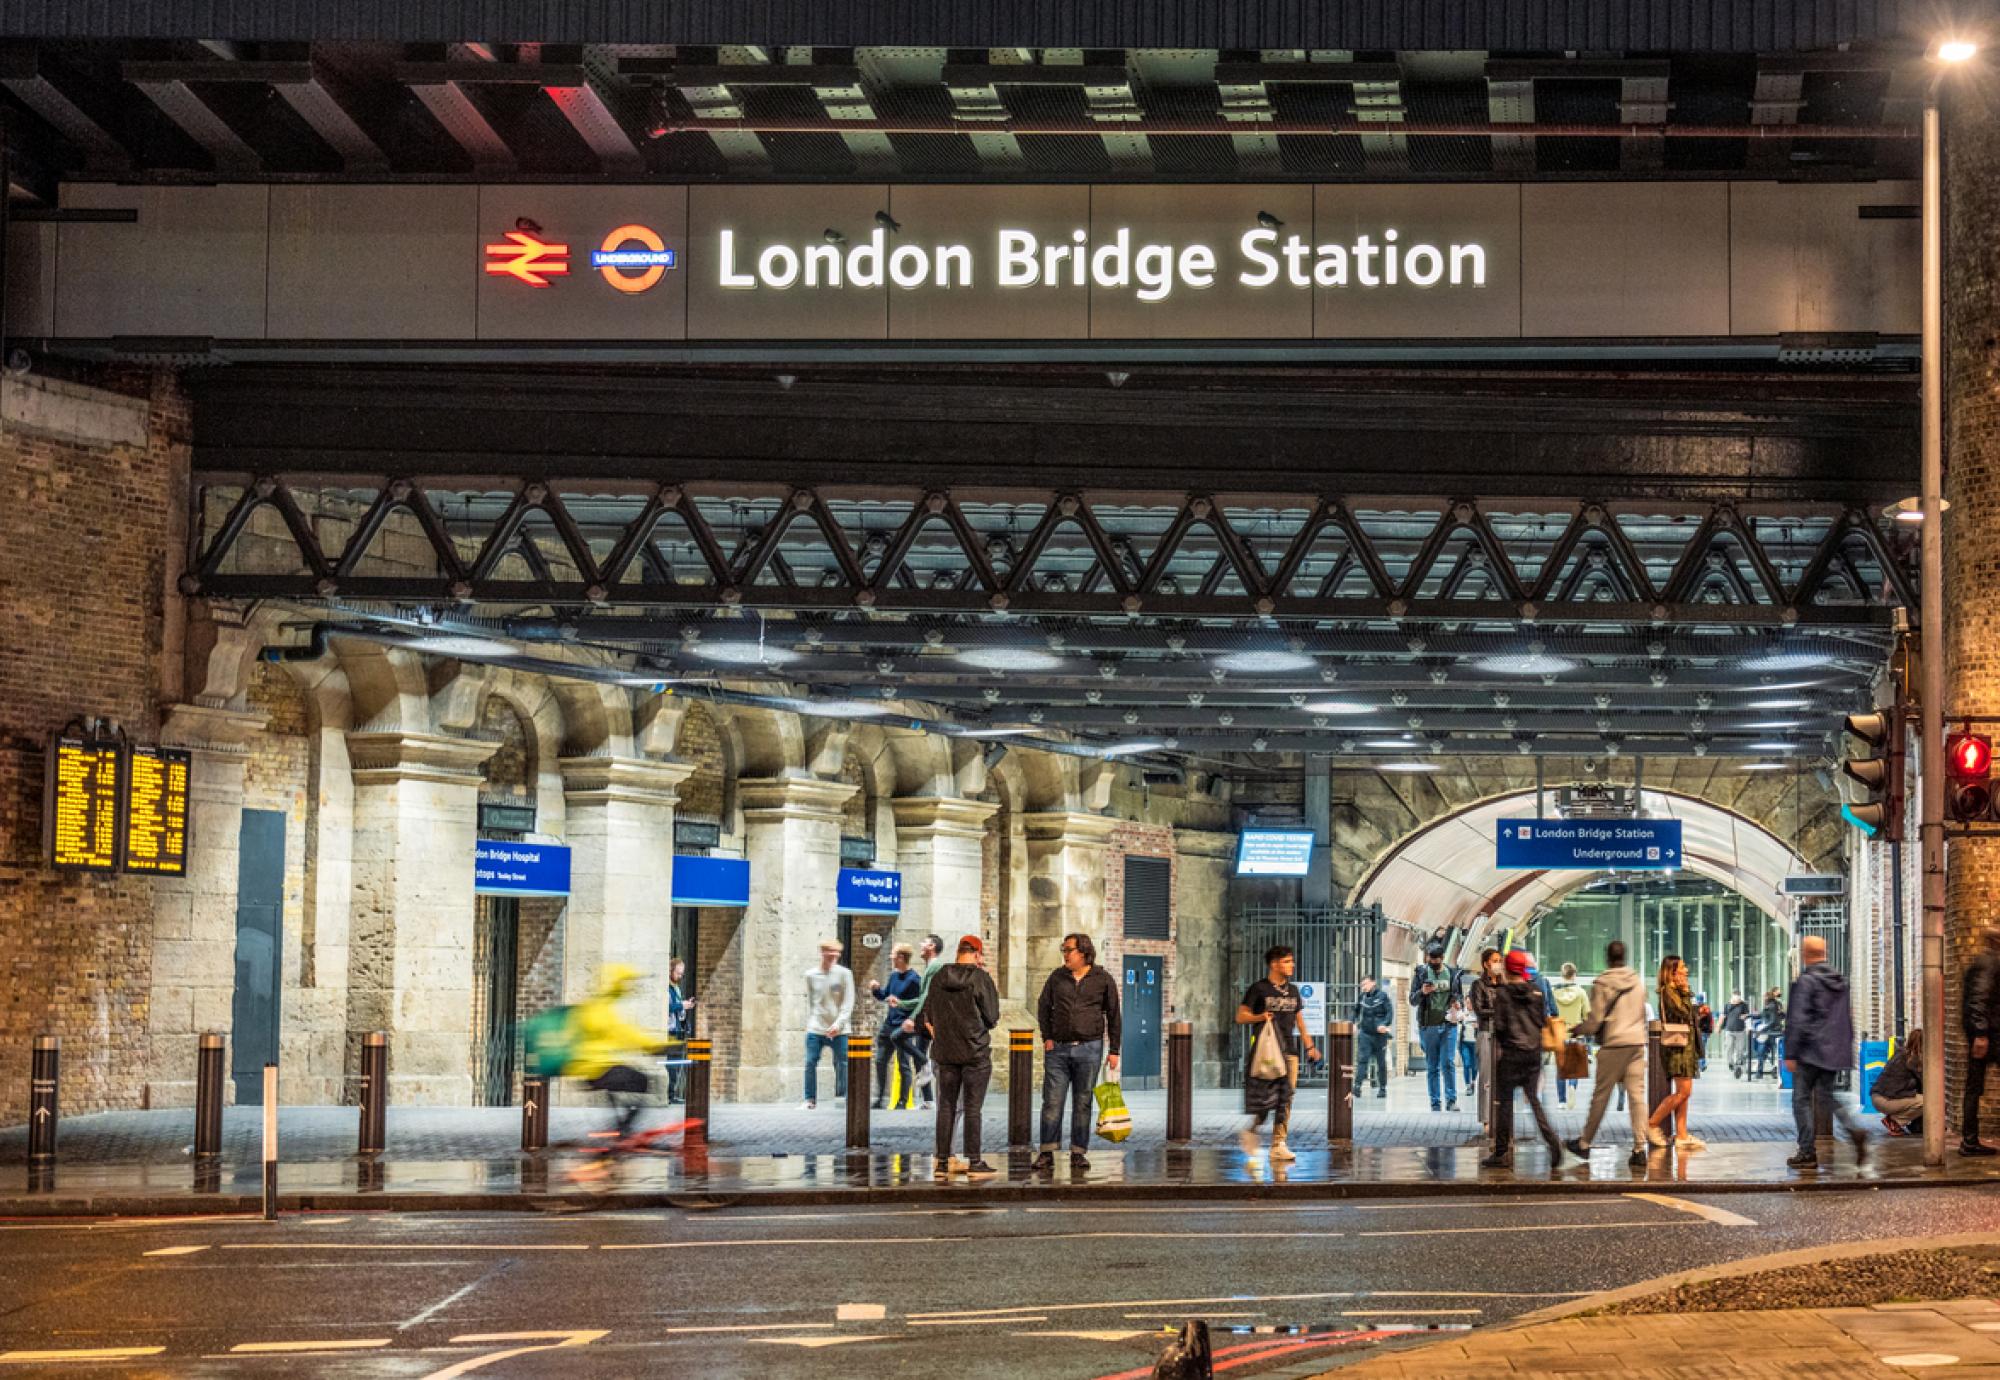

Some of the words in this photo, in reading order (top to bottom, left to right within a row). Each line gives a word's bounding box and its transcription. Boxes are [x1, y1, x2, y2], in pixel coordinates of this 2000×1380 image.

[595, 253, 671, 263] UNDERGROUND
[718, 227, 972, 287] London
[998, 227, 1216, 302] Bridge
[1239, 227, 1487, 287] Station
[1535, 827, 1575, 839] London
[1578, 827, 1613, 842] Bridge
[1615, 827, 1655, 840] Station
[489, 849, 511, 863] Bridge
[512, 851, 540, 863] Hospital
[1573, 848, 1643, 861] Underground
